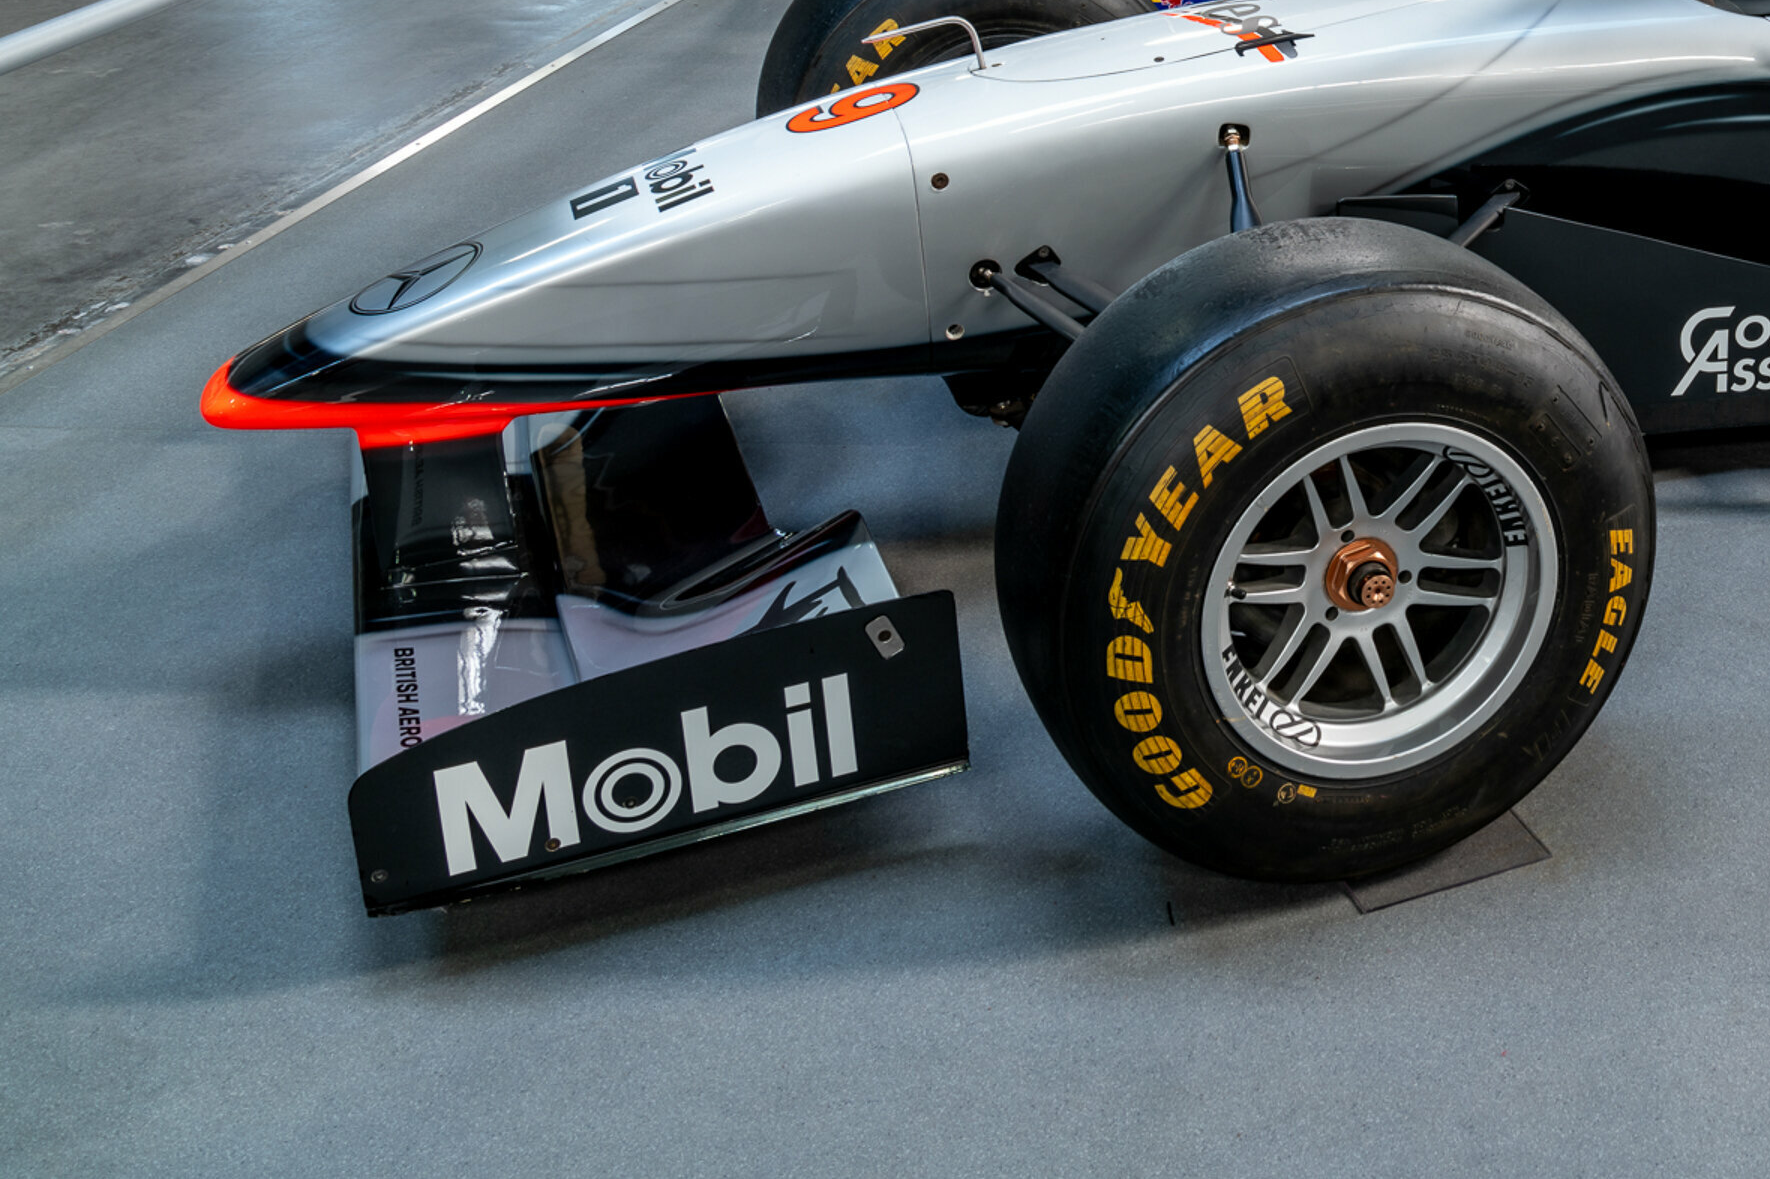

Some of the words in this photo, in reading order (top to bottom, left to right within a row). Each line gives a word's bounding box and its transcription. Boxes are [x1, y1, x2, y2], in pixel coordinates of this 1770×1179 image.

[1578, 528, 1634, 696] EAGLE
[394, 646, 419, 703] BRITISH
[1221, 642, 1272, 721] ENKEI
[433, 673, 858, 876] Mobil
